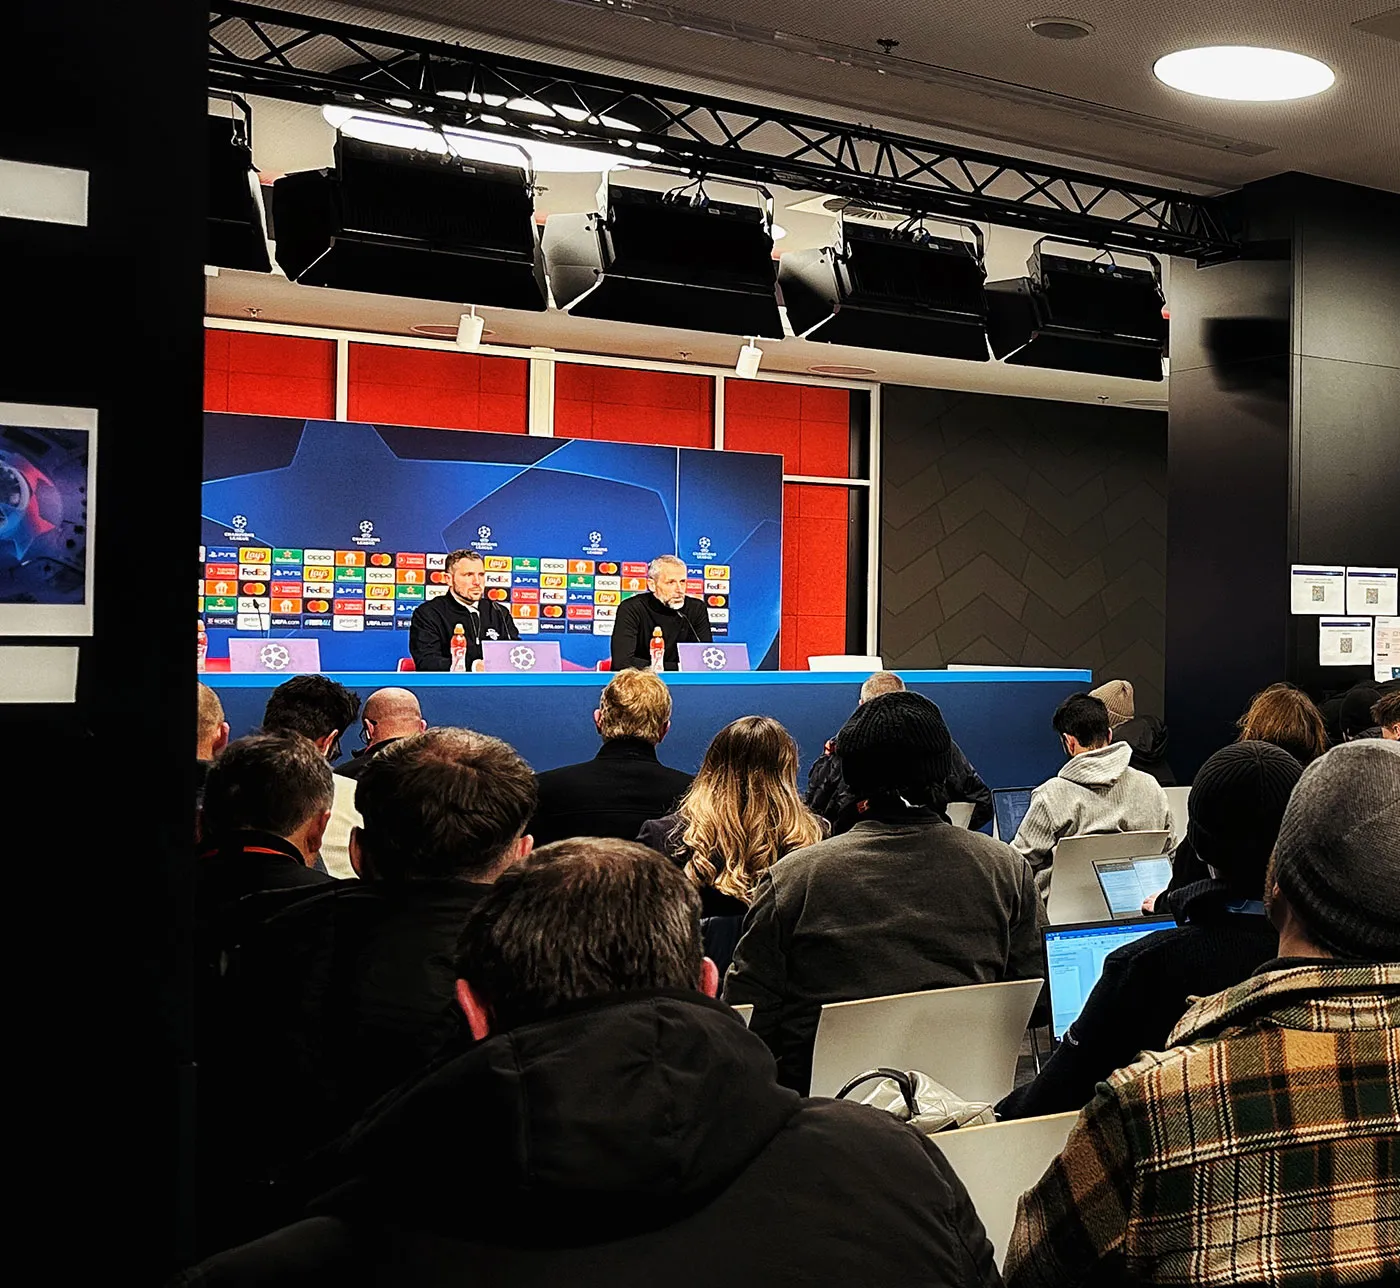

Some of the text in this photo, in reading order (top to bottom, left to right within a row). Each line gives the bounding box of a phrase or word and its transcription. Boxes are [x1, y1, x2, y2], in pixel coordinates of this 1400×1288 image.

[307, 554, 331, 562] oppo
[242, 568, 267, 576] FedEx
[306, 586, 330, 594] FedEx
[367, 603, 392, 611] FedEx
